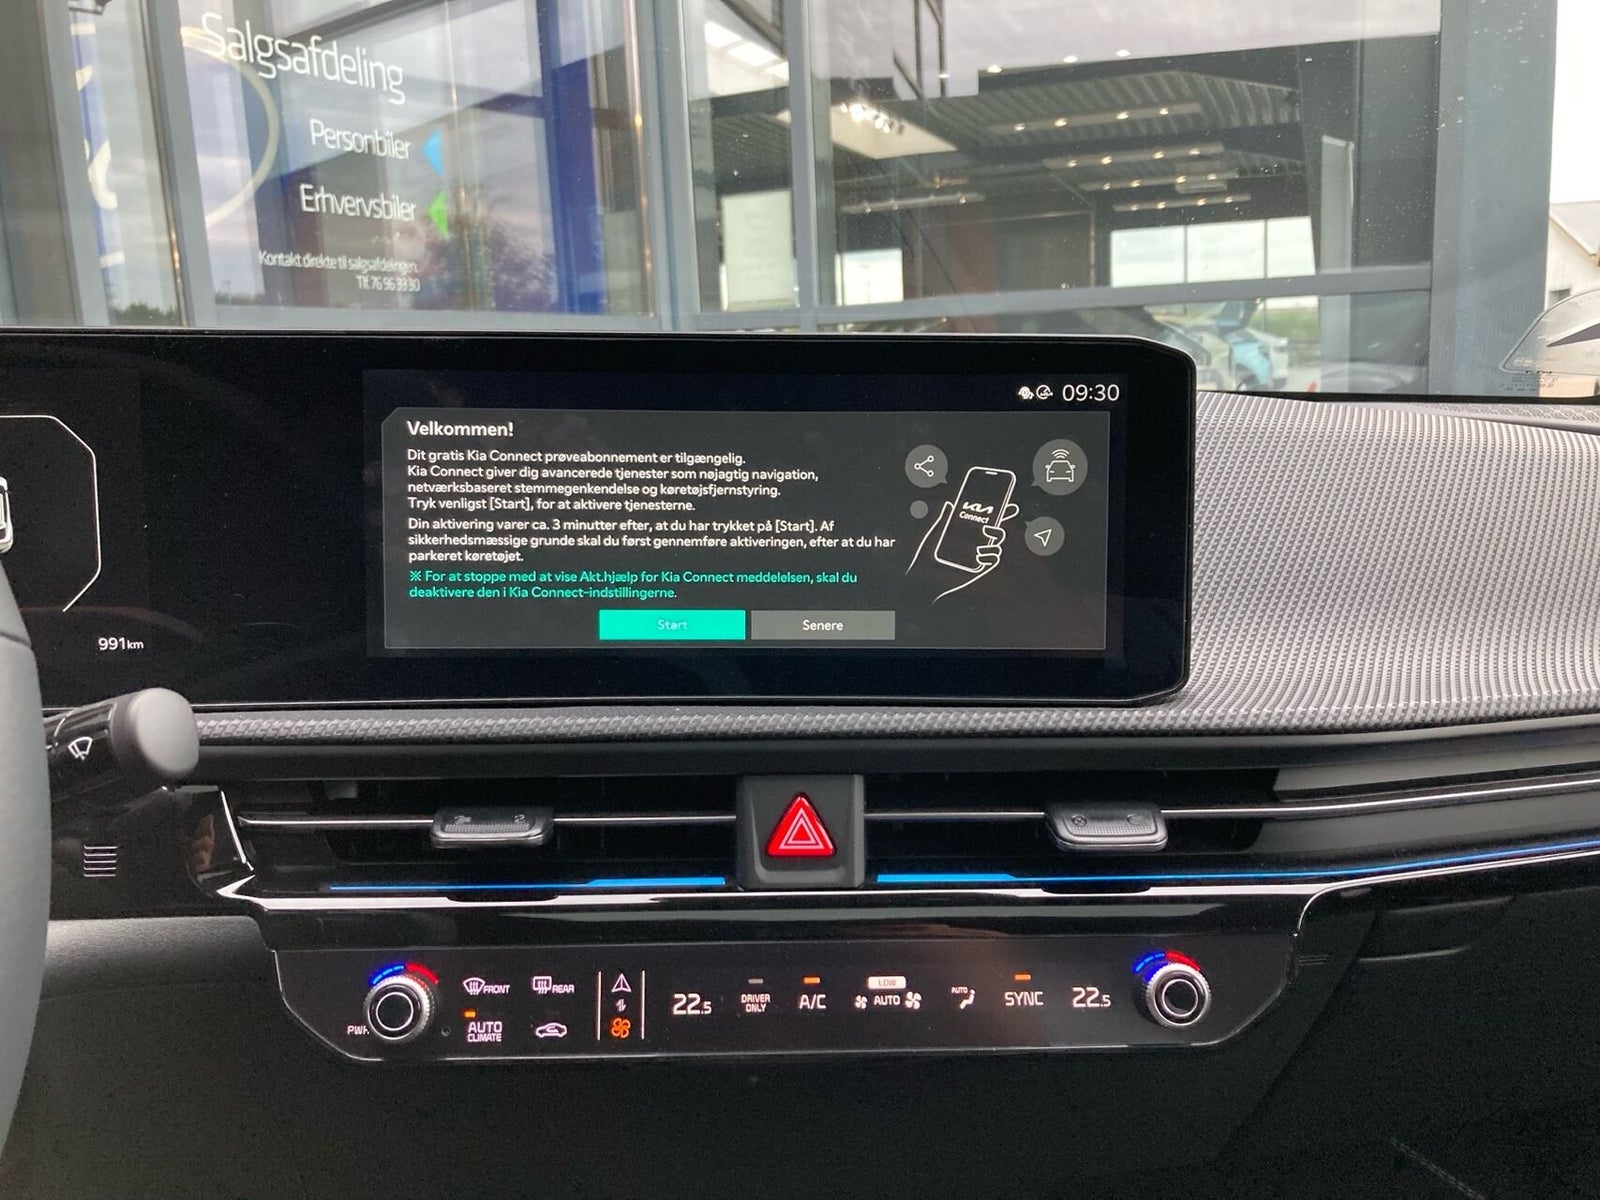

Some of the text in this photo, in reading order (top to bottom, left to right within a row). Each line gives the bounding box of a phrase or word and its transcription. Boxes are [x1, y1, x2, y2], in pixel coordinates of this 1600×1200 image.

[201, 12, 405, 105] Salgsafdeling
[309, 118, 411, 160] Personbiler
[300, 183, 417, 222] Erhvervsbiler
[258, 250, 301, 268] Kontakt
[1062, 384, 1120, 402] 09:30
[406, 420, 513, 437] Velkommen!
[407, 448, 746, 467] Dit gratis Kia Connect prøveabonnement er tilgængelig.
[407, 465, 819, 483] Kia Connect giver dig avancerede tjenester som nøjagtig navigation,
[407, 481, 781, 498] netværksbaseret stemmegenkendelse og køretøjsfjernstyring.
[407, 496, 696, 512] Tryk venligst [Start], for at aktivere tjenesterne.
[959, 511, 989, 524] Connect
[408, 517, 835, 534] Din aktivering varer ca. 3 minutter efter, at du har trykket på [Start]. Af
[407, 533, 896, 550] sikkerhedsmæssige grunde skal du først gennemføre aktiveringen, efter at du har
[408, 549, 524, 564] parkeret køretøjet.
[425, 570, 857, 585] For at stoppe med at vise Akt.hjælp for Kia Connect meddelelsen, skal du
[409, 586, 677, 601] deaktivere den i Kia Connect-indstillingerne.
[657, 619, 688, 631] Start
[802, 619, 844, 631] Senere
[483, 984, 510, 994] FRONT
[552, 984, 575, 994] REAR
[951, 986, 968, 994] AUTO
[673, 993, 712, 1015] 22.5
[741, 994, 771, 1003] DRIVER
[799, 994, 827, 1009] A/C
[873, 995, 901, 1006] AUTO
[1004, 991, 1044, 1006] SYNC
[1072, 986, 1112, 1008] 22.5
[745, 1003, 767, 1012] ONLY
[468, 1021, 503, 1033] AUTO
[467, 1033, 502, 1042] CLIMATE
